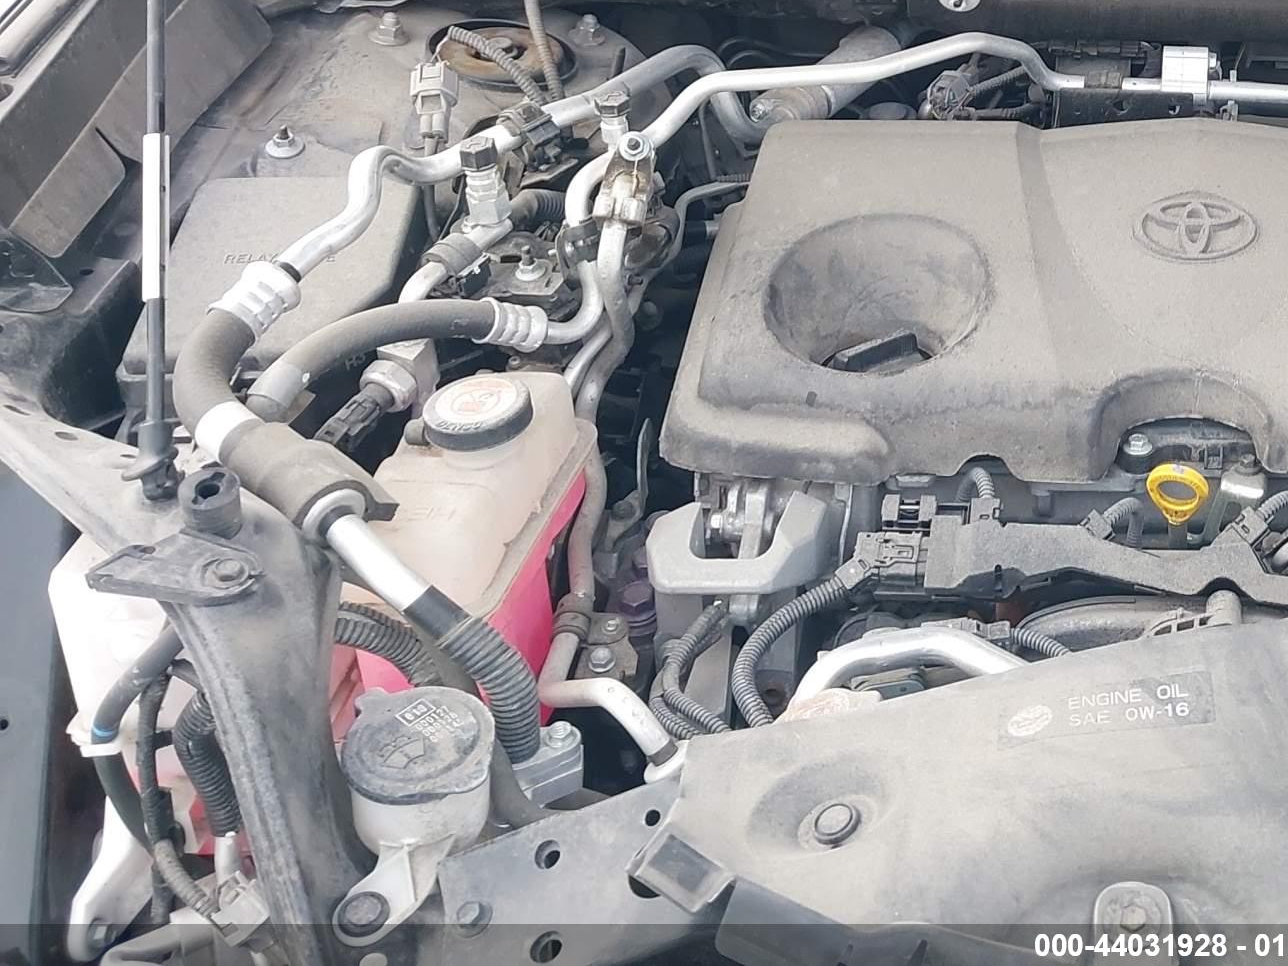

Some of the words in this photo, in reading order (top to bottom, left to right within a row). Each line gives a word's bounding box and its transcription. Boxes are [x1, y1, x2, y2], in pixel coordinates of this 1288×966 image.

[1069, 688, 1143, 710] ENGINE
[1156, 683, 1189, 700] OIL
[1069, 710, 1111, 727] SAE
[1125, 702, 1190, 723] 0W-16
